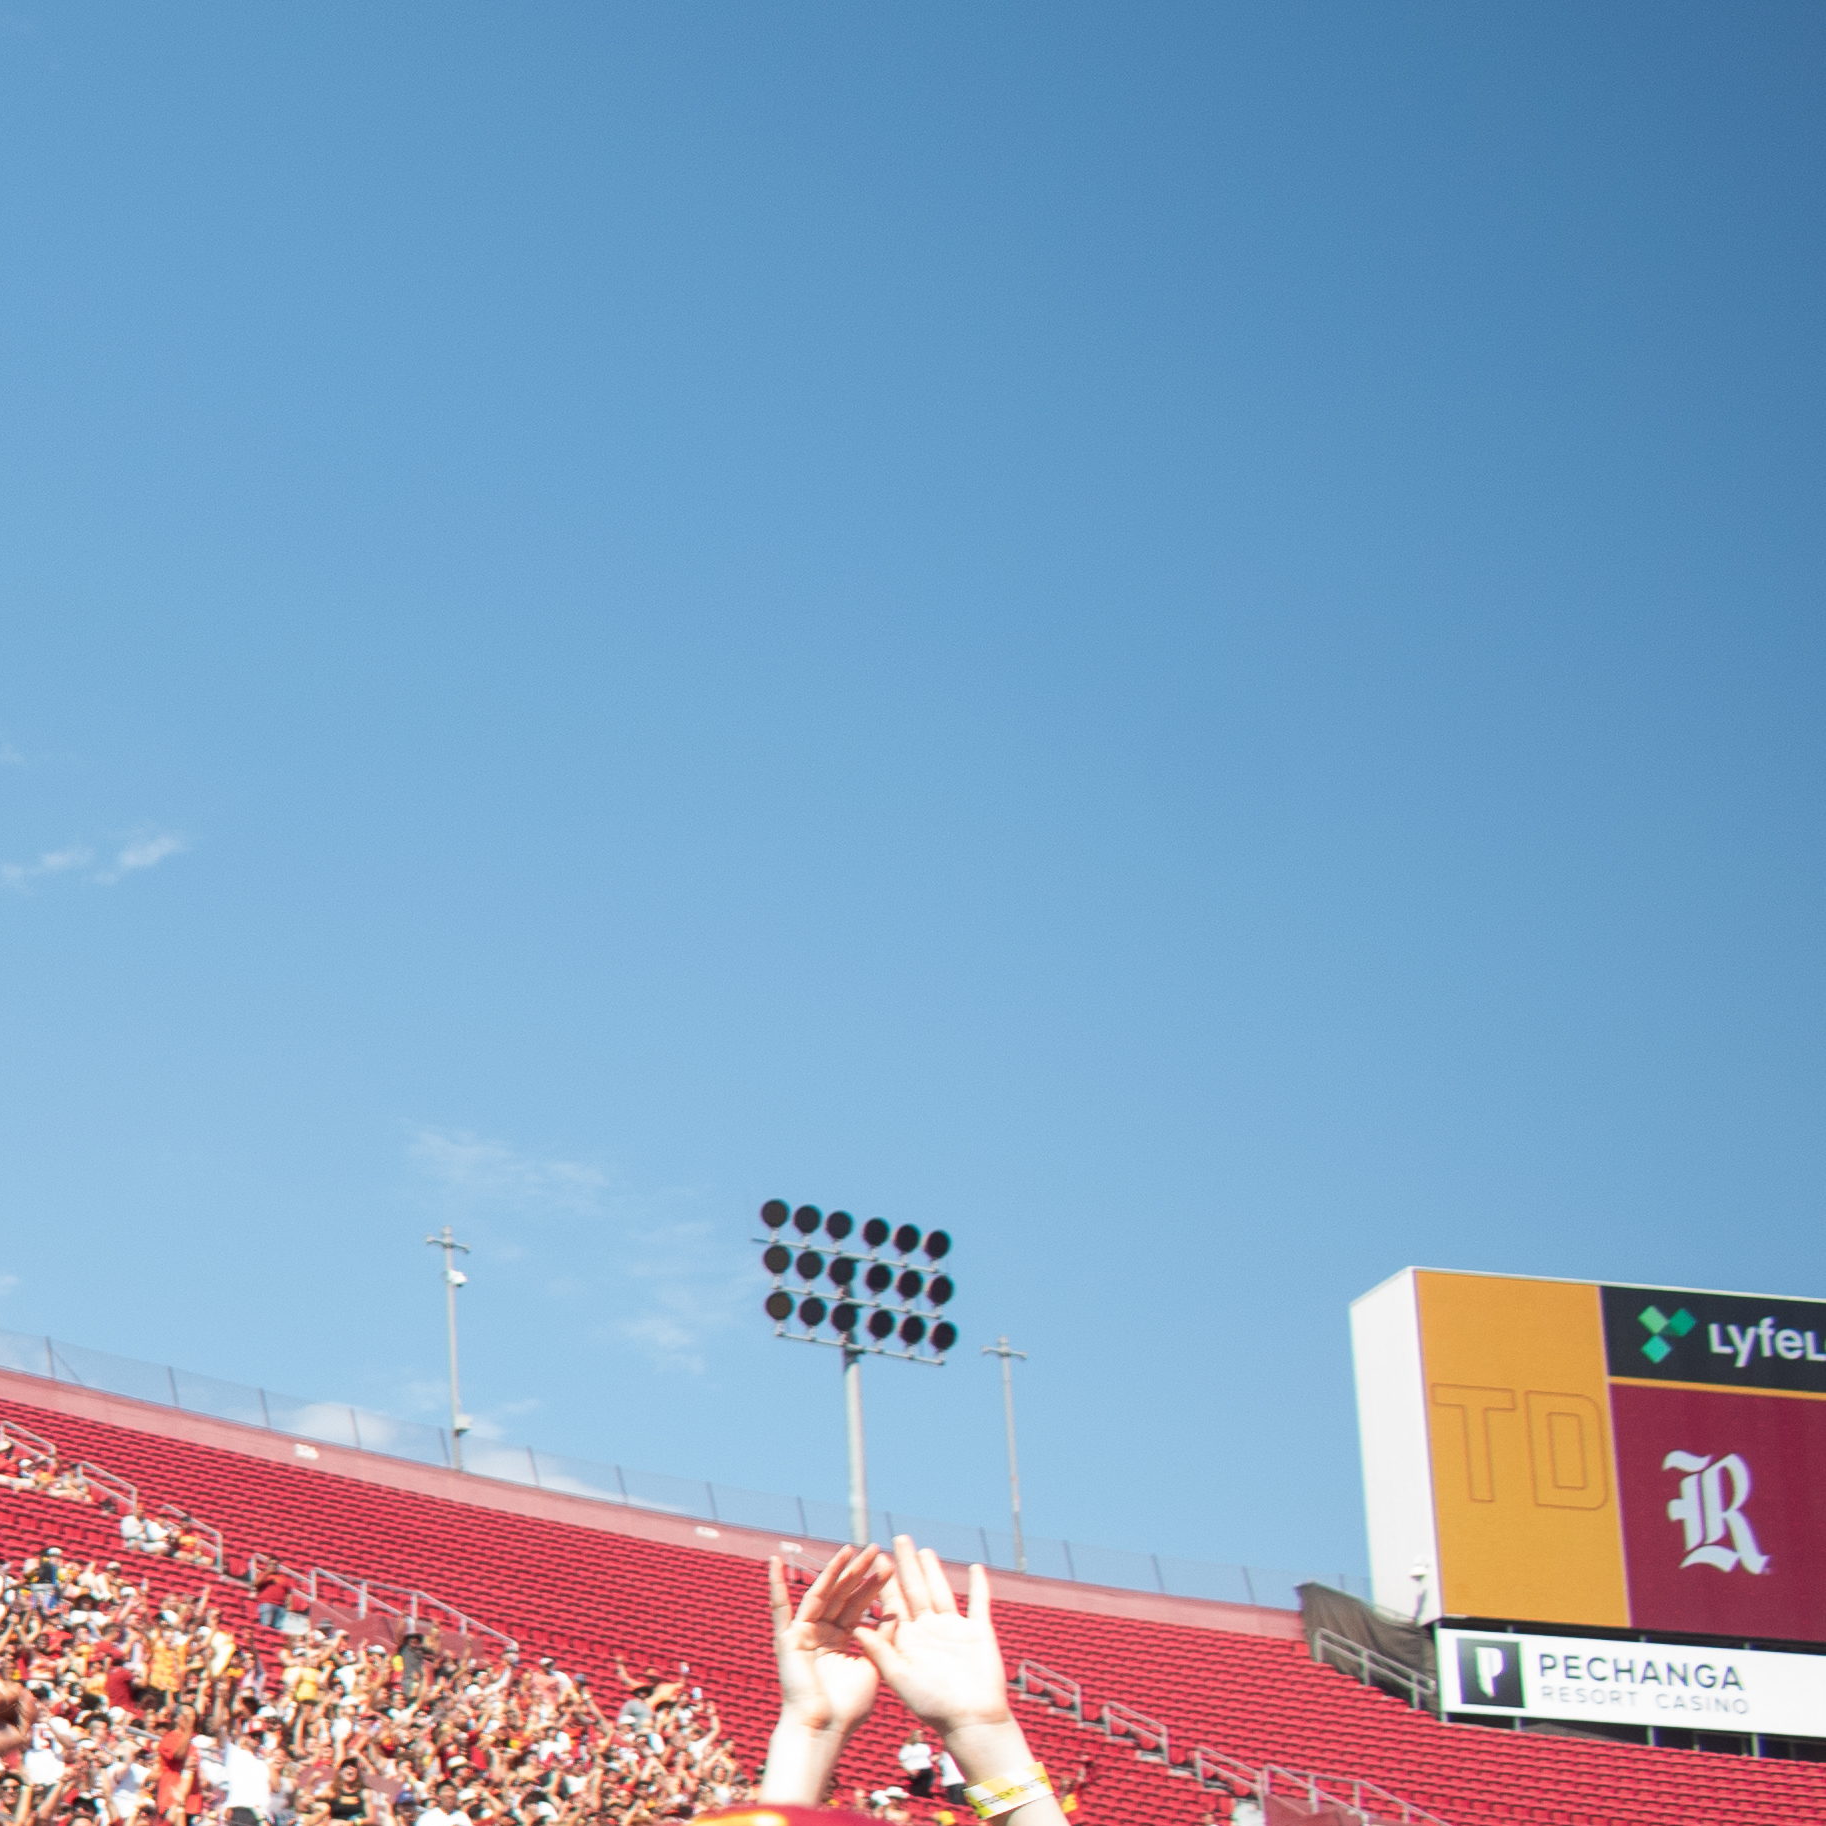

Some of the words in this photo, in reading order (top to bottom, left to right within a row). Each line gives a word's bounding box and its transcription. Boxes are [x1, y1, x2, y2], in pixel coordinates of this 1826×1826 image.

[1707, 1316, 1826, 1368] LyfeL
[1430, 1382, 1608, 1511] TD
[1539, 1653, 1746, 1691] PECHANGA
[1541, 1685, 1638, 1707] RESORT
[1656, 1693, 1750, 1715] CASINO
